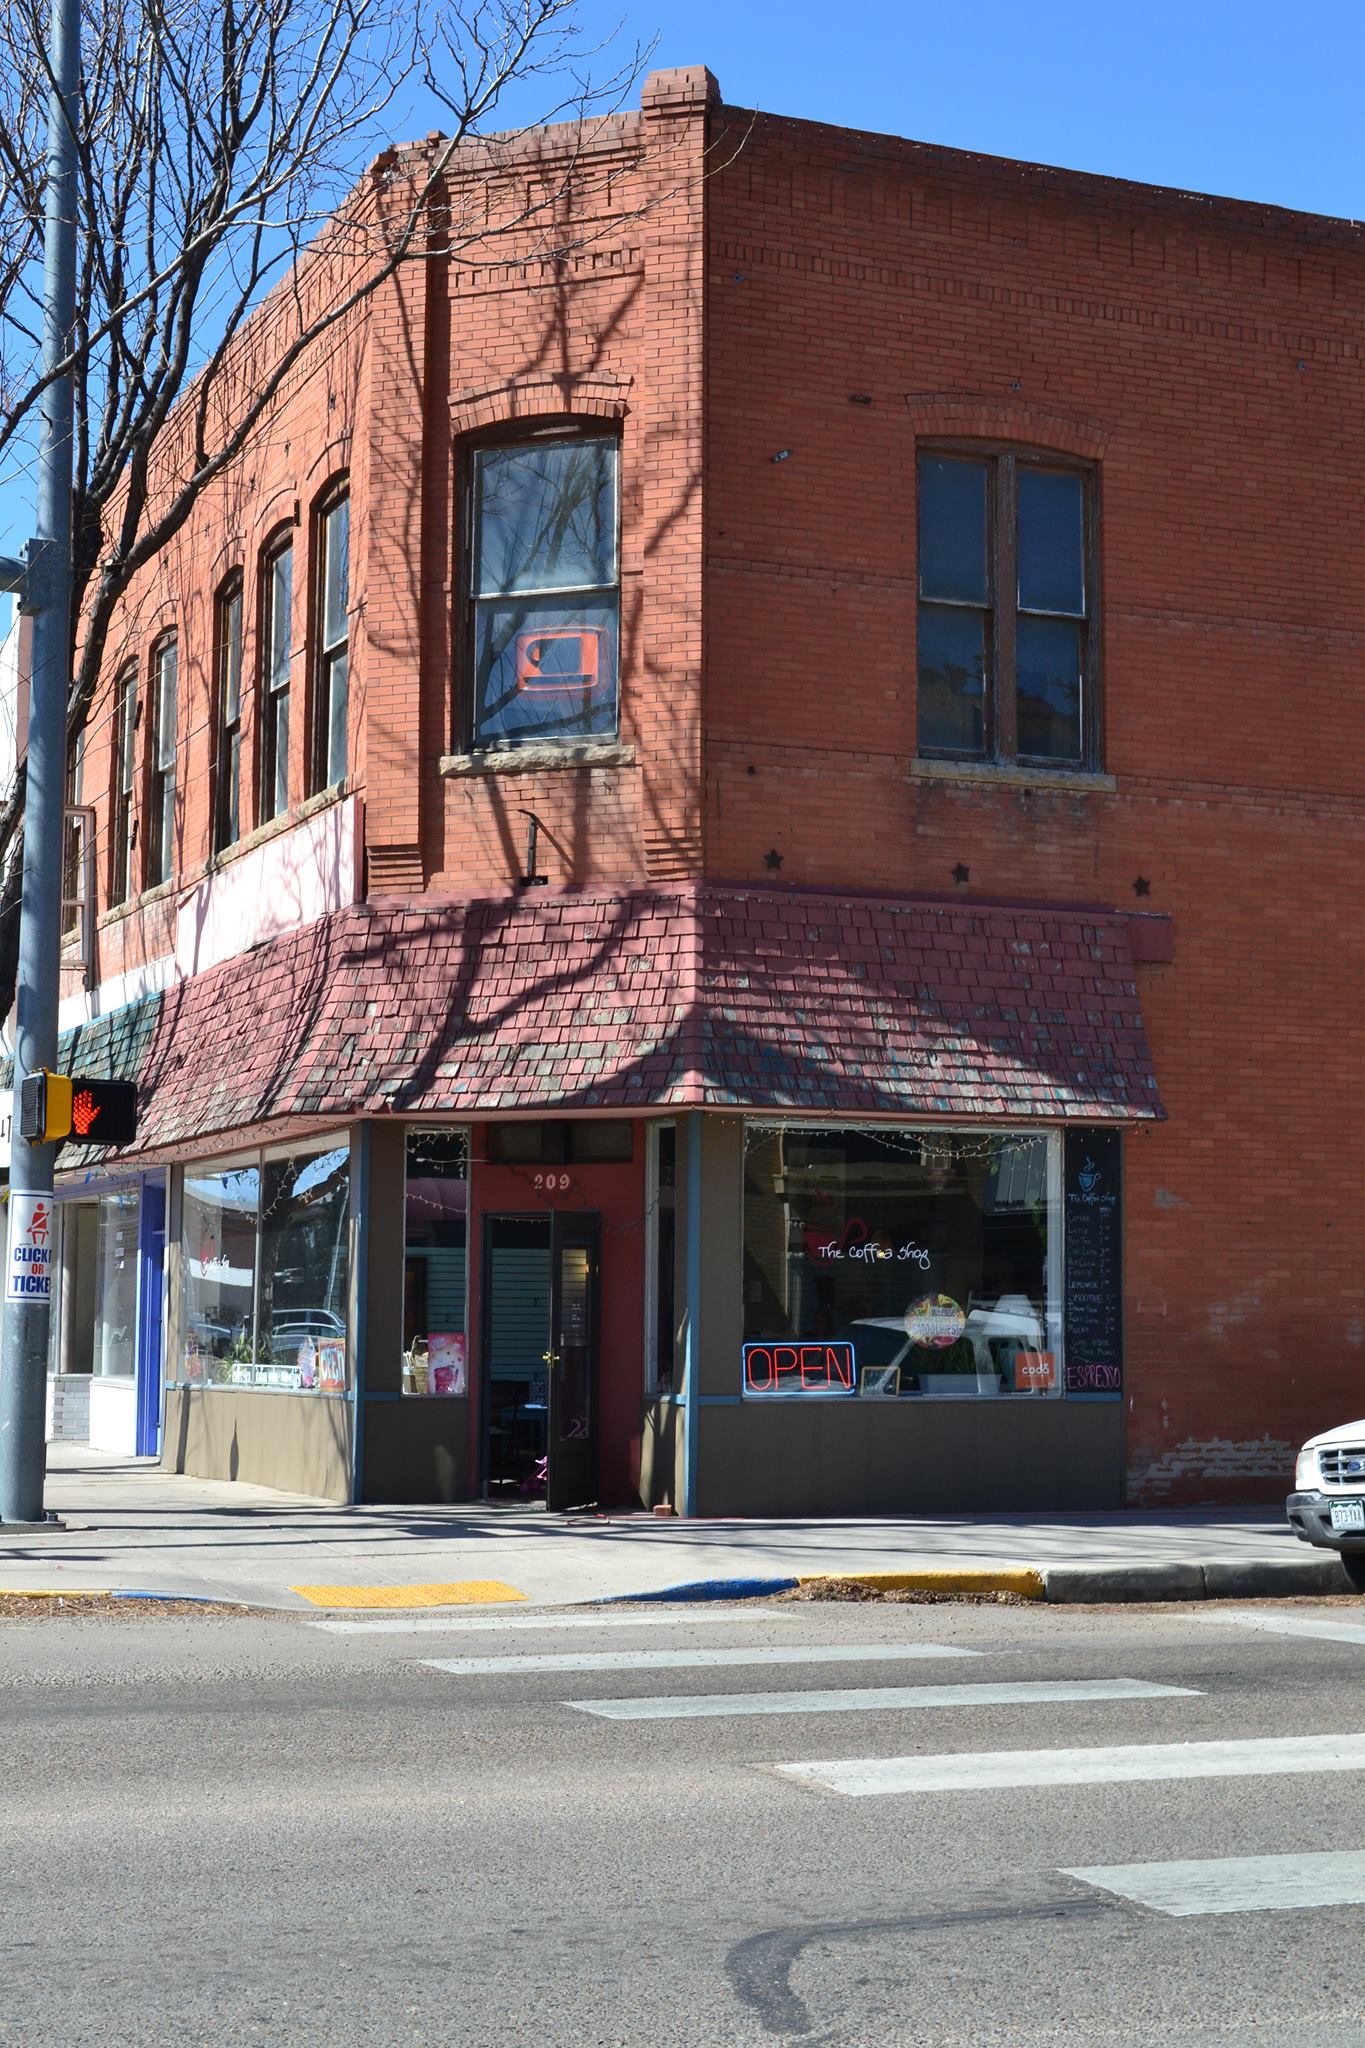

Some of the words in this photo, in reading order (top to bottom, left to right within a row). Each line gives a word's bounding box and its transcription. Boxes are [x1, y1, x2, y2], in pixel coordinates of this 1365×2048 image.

[534, 1174, 570, 1190] 209
[31, 1263, 44, 1275] OR
[747, 1347, 851, 1391] OPEN
[1067, 1365, 1121, 1389] ESPRESSO
